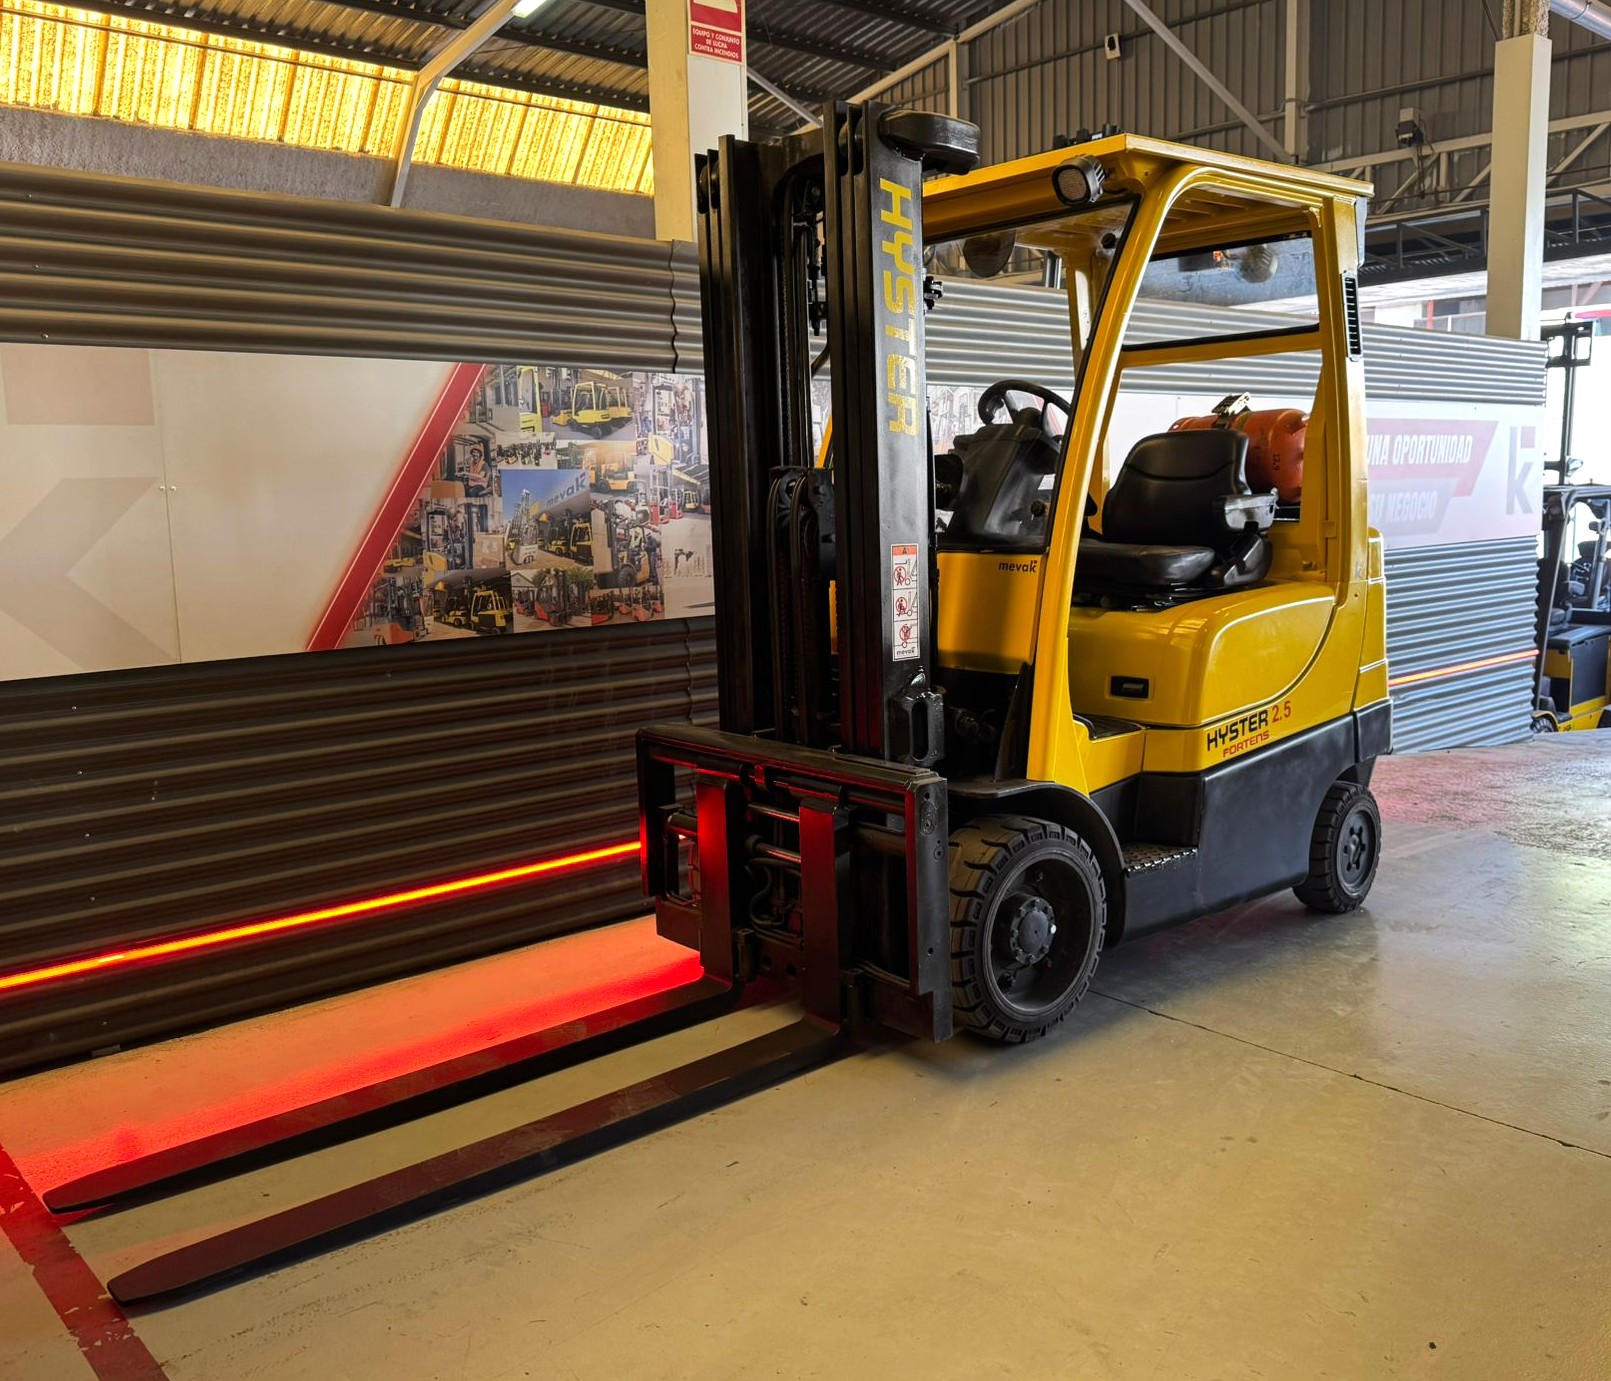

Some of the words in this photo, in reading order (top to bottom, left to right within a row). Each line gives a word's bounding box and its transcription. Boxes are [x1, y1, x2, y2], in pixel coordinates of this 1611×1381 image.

[693, 28, 710, 37] EQUIPO
[716, 33, 740, 44] CONJUNTO
[695, 43, 713, 52] CONTRA
[714, 48, 739, 58] INCENDIOS
[712, 40, 728, 49] LUCHA
[879, 177, 920, 437] HYSTER
[1391, 434, 1473, 465] OPORTUNIDAD
[546, 471, 587, 508] mevak
[1385, 489, 1438, 523] NEGOCIO
[998, 560, 1038, 573] mevak
[1207, 709, 1269, 752] HYSTER
[1271, 700, 1291, 723] 2.5
[1222, 730, 1270, 758] FORTENS
